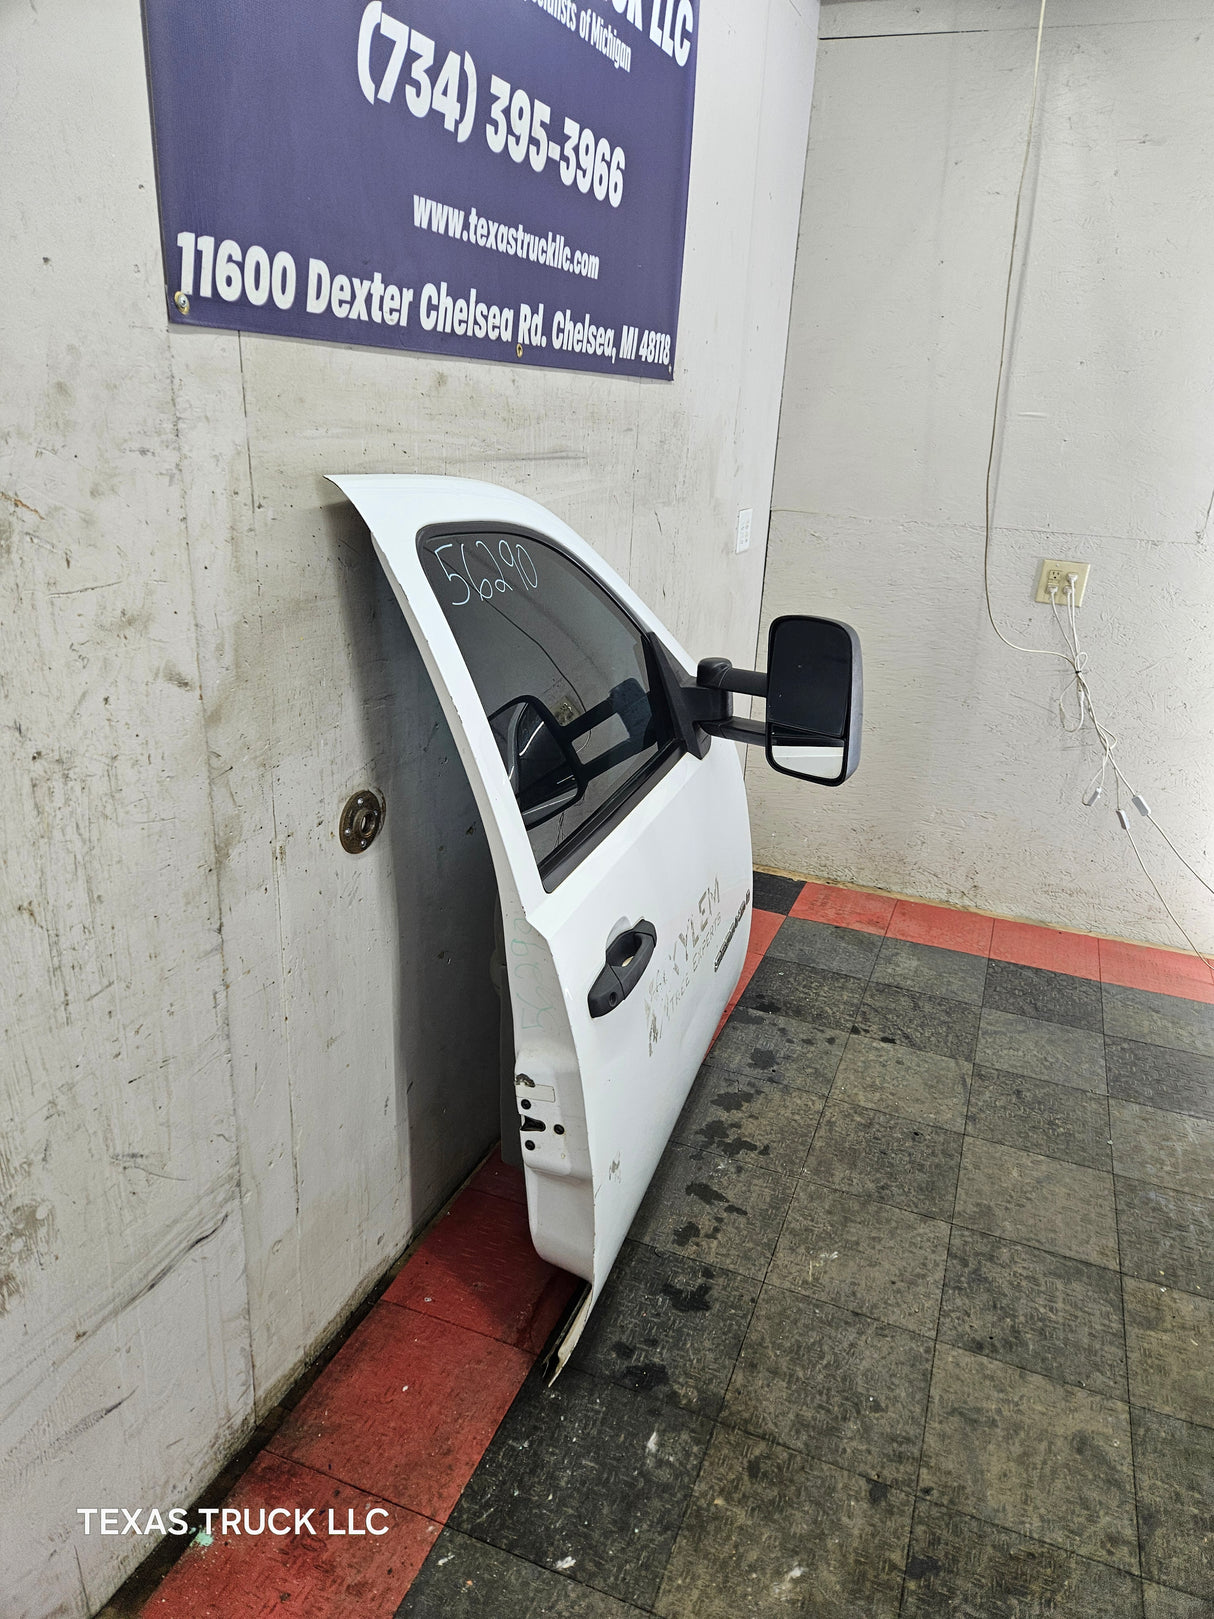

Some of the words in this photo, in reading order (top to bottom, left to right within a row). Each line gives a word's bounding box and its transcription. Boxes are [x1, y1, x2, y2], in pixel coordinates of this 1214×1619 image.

[579, 8, 592, 42] of
[590, 11, 632, 73] Michigan
[649, 0, 694, 67] LLC
[357, 0, 478, 143] (734)
[485, 74, 626, 208] 395-3966
[413, 194, 600, 280] www.texastruckllc.com
[177, 231, 297, 310] 11600
[306, 257, 414, 327] Dexter
[419, 281, 514, 342] Chelsea
[517, 303, 547, 348] Rd.
[551, 309, 617, 364] Chelsea,
[619, 324, 639, 360] MI
[638, 329, 671, 366] 48118
[434, 539, 538, 606] 56290
